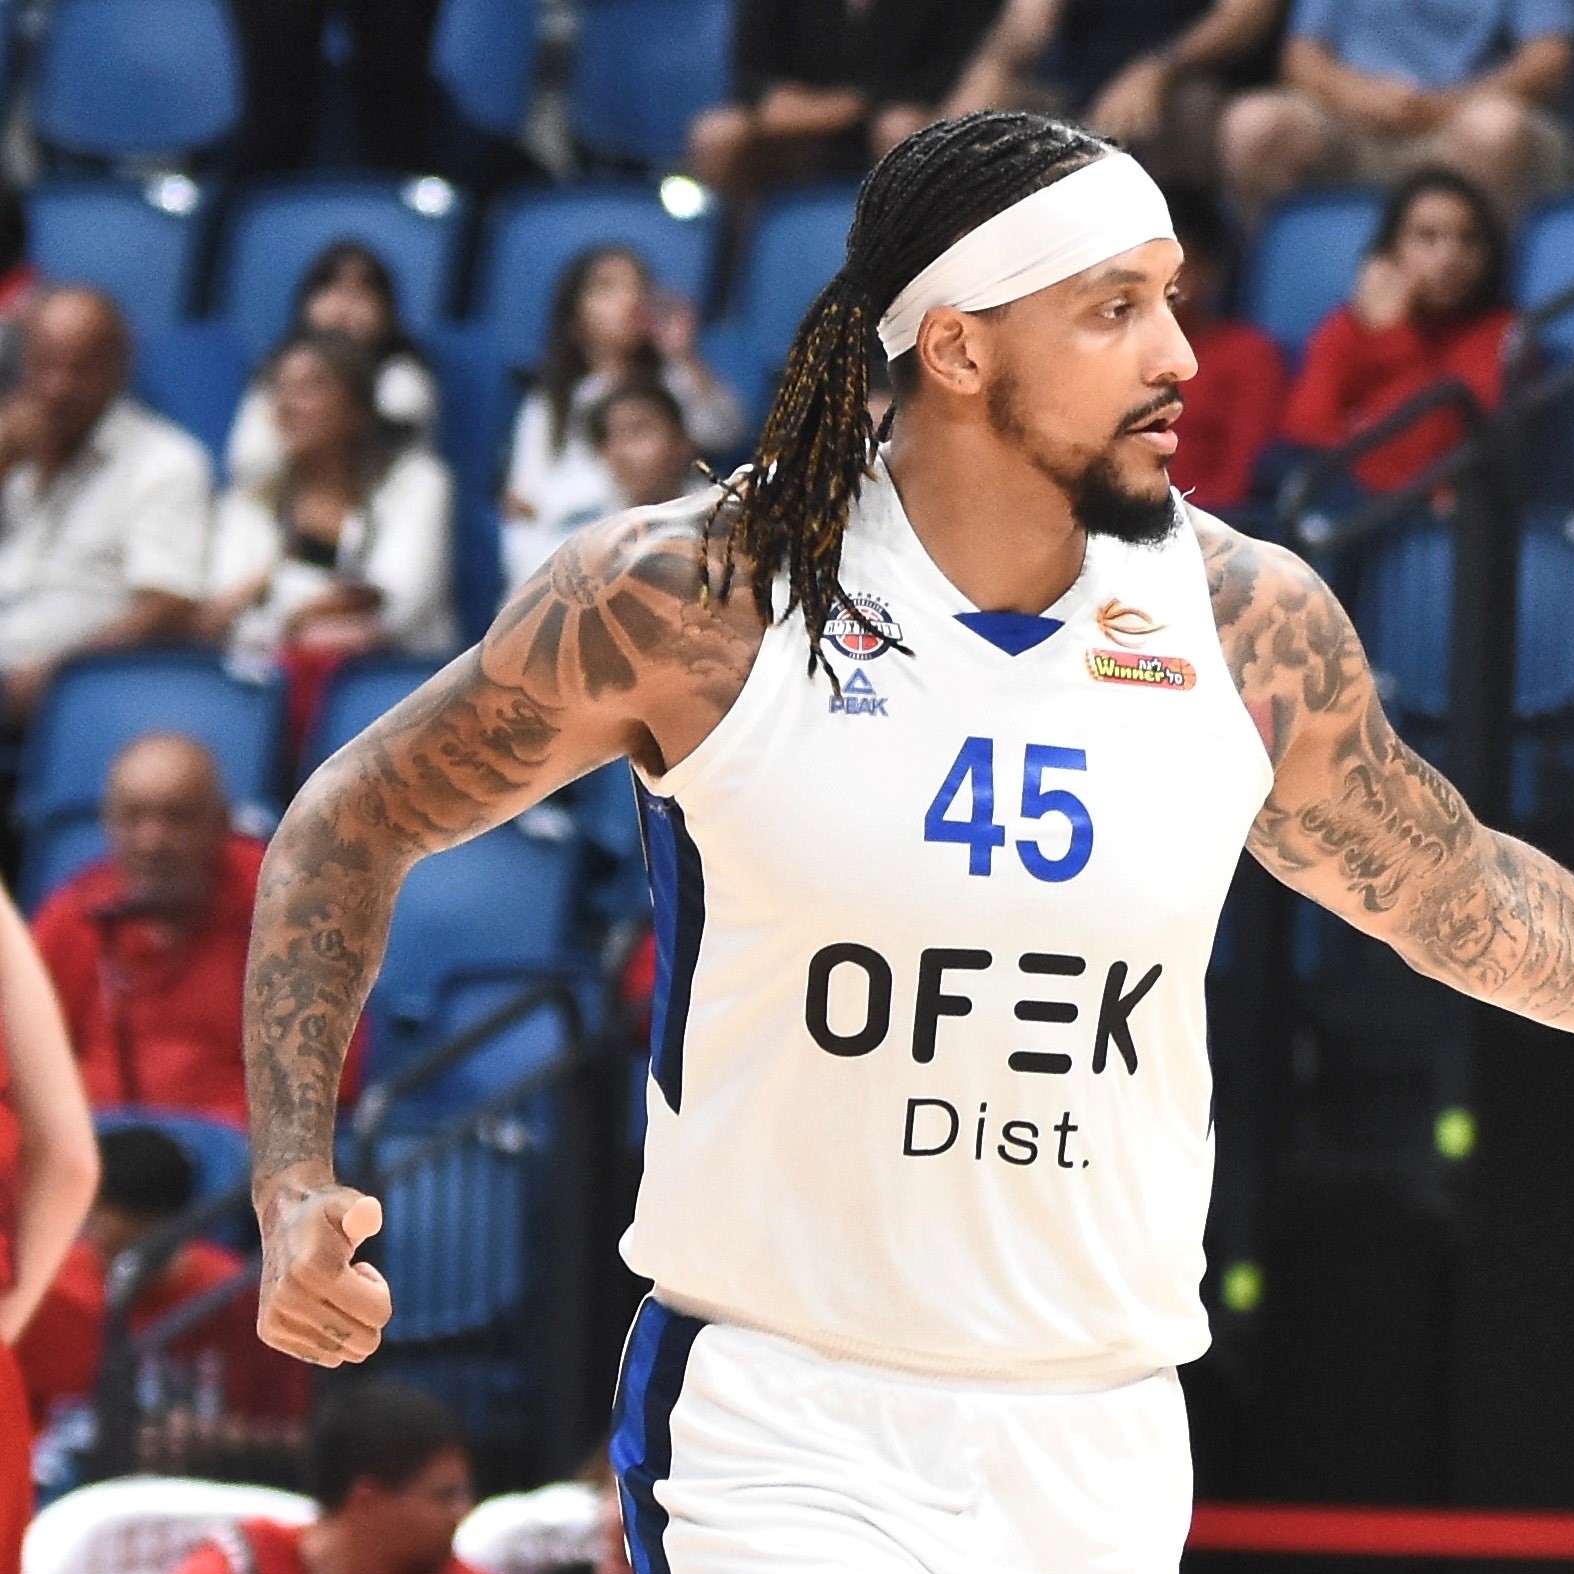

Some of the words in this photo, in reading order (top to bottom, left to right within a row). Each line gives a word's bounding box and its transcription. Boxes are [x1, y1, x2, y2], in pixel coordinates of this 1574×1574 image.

[1095, 655, 1165, 683] Winner
[1165, 667, 1184, 685] סל
[828, 695, 889, 716] PEAK
[923, 736, 1094, 883] 45
[805, 942, 1163, 1076] OFEK
[903, 1097, 1090, 1169] Dist.
